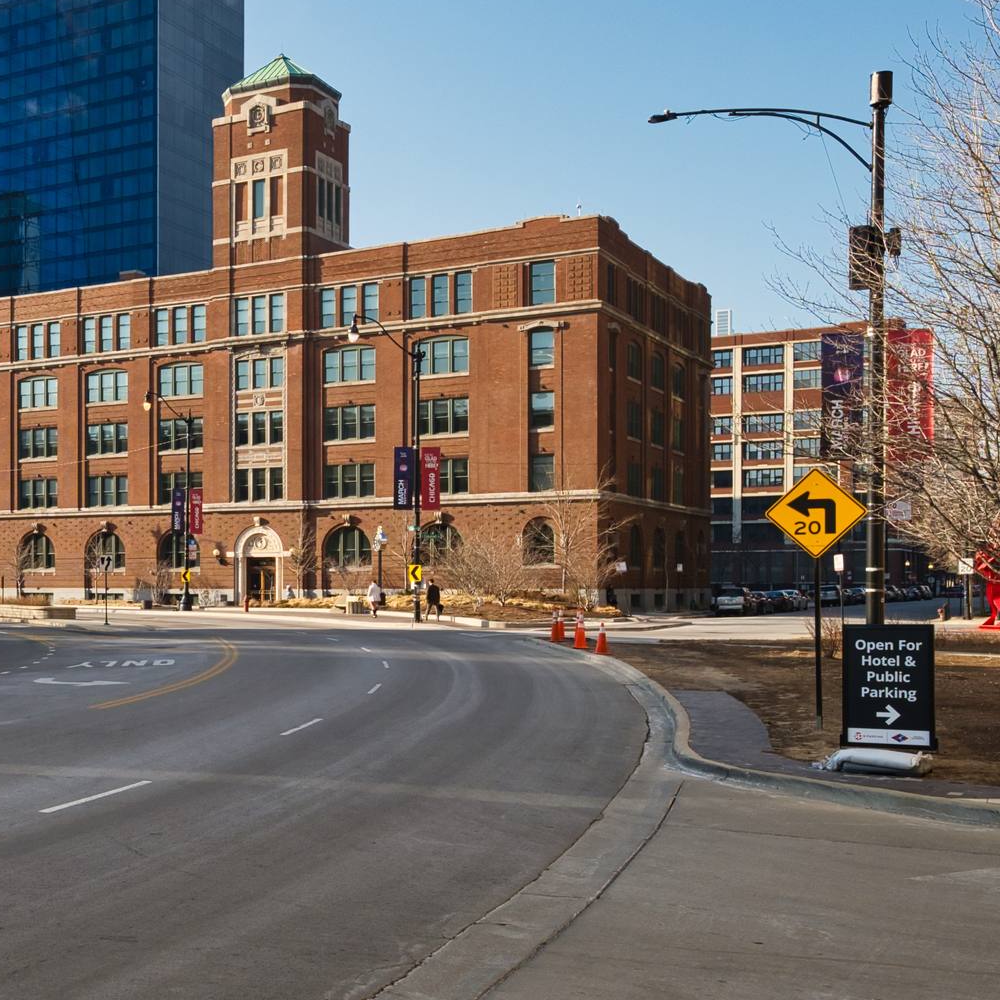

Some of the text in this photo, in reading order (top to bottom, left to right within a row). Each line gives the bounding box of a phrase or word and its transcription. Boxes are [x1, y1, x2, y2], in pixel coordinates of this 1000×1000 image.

[794, 521, 821, 535] 20
[855, 639, 923, 653] Open For
[65, 659, 176, 668] ONLY
[861, 655, 917, 667] Hotel &
[866, 671, 911, 683] Public
[861, 686, 917, 702] Parking
